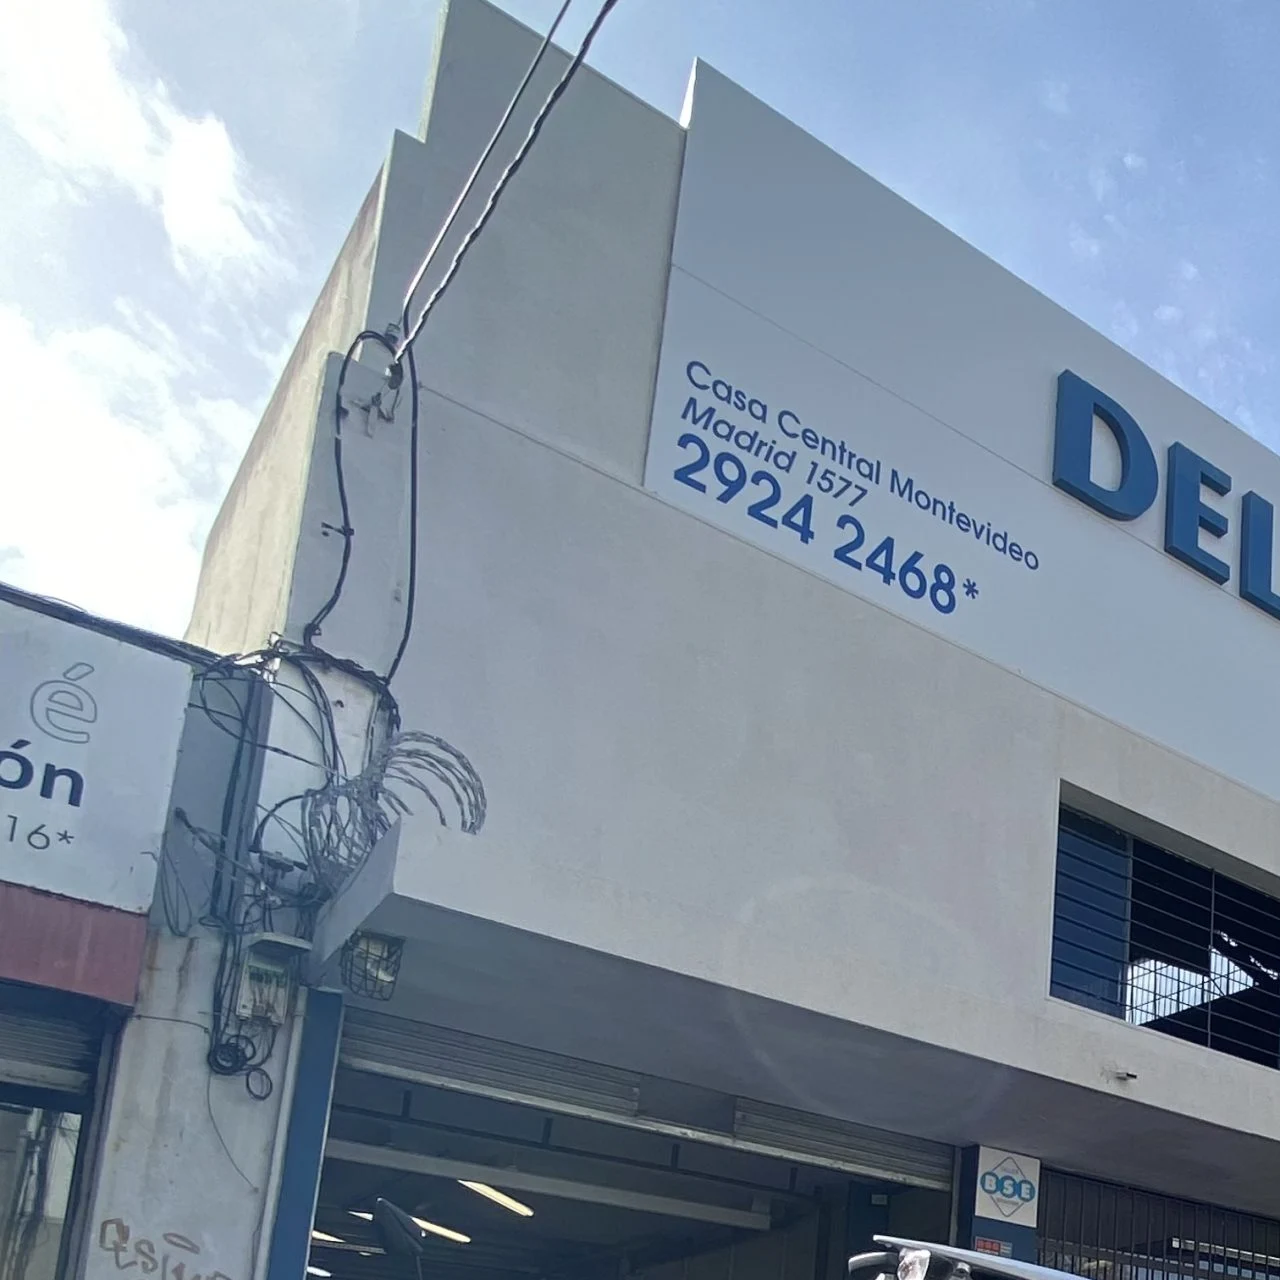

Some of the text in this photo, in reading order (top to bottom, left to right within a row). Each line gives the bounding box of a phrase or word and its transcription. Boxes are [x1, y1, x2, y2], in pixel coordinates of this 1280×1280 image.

[673, 433, 815, 544] 2924
[680, 397, 868, 508] Madrid 1577
[686, 361, 1039, 570] Casa Central Montevideo
[983, 1173, 1032, 1201] BSE
